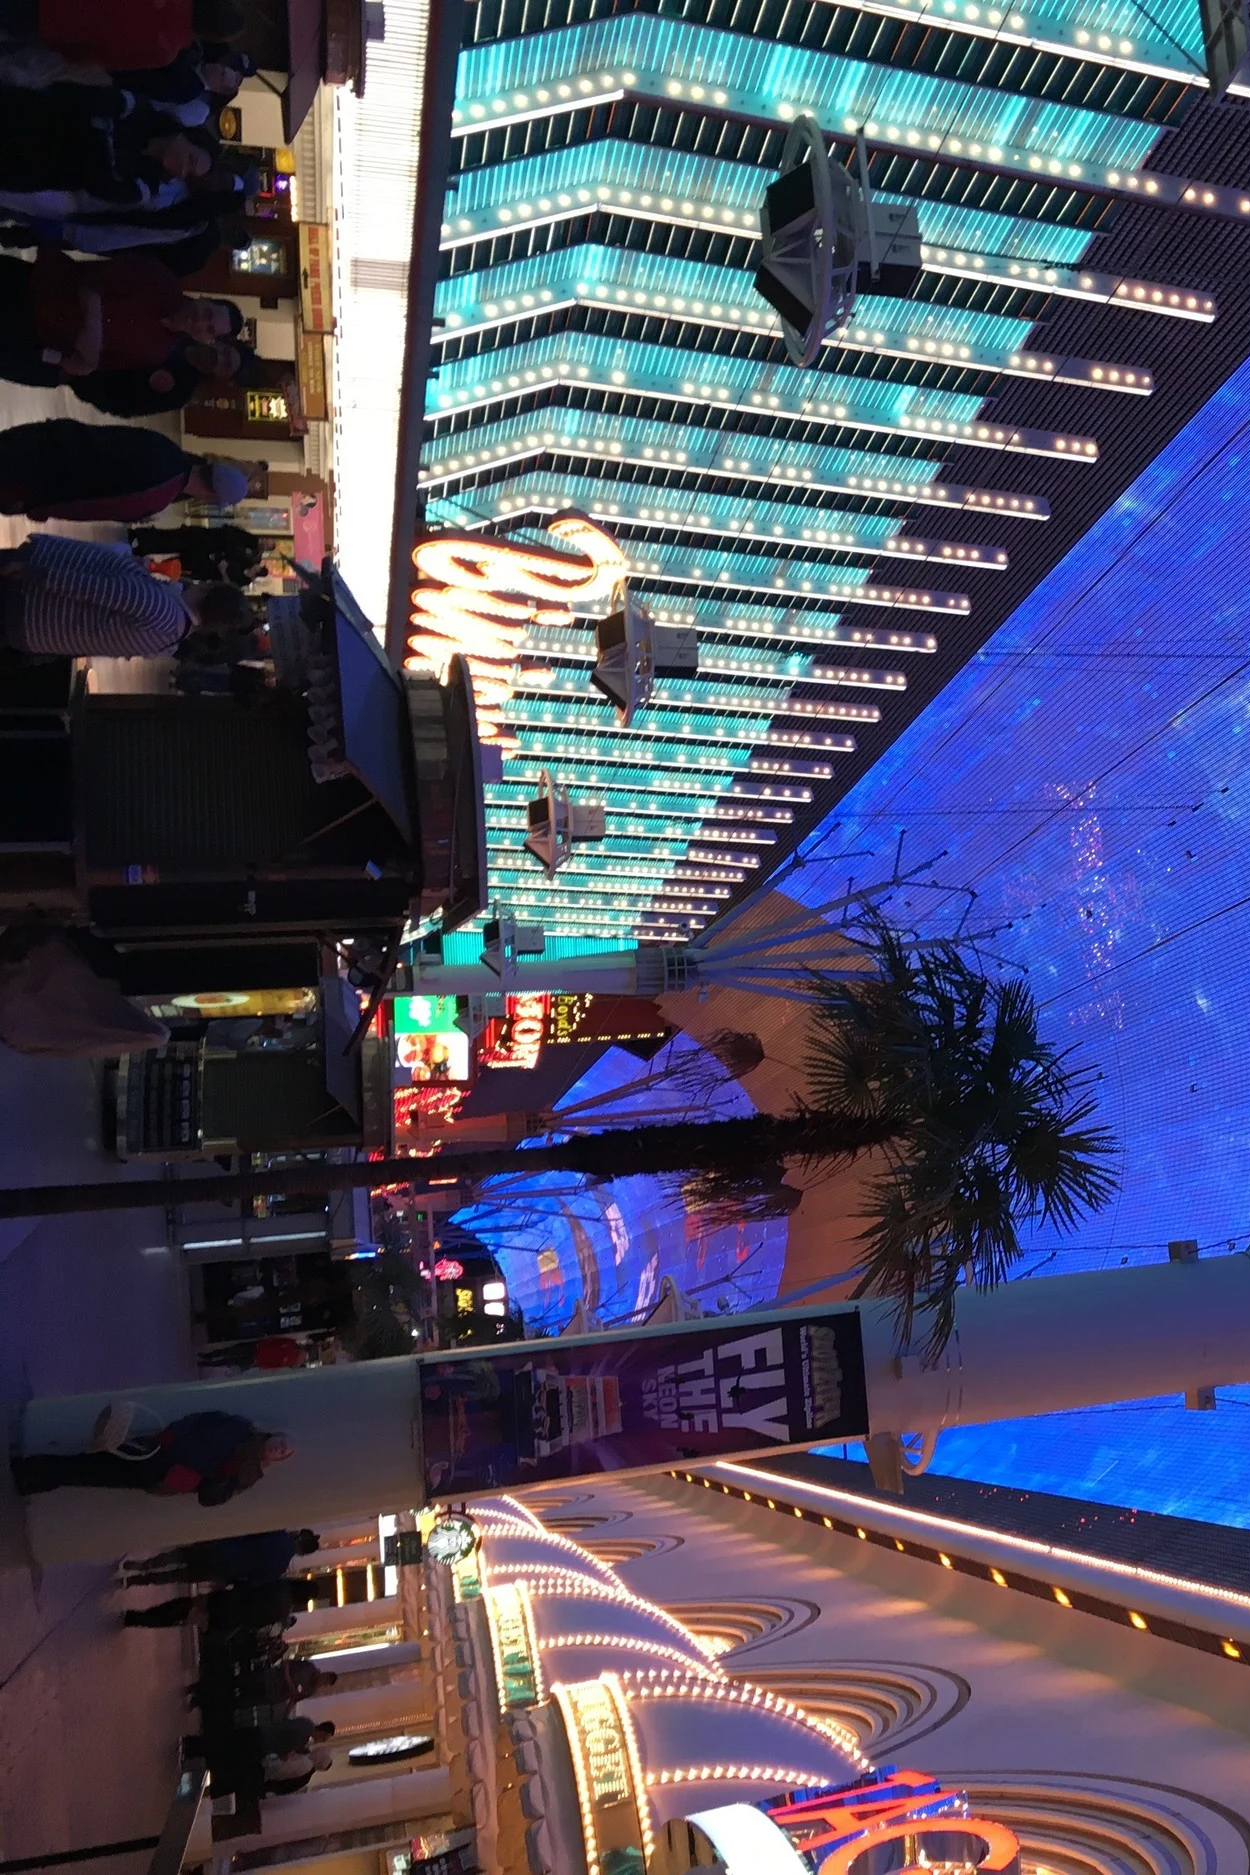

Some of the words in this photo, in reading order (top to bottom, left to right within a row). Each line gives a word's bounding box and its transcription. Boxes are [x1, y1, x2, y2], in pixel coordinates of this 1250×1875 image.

[554, 995, 574, 1036] Boyd's
[641, 1378, 660, 1421] SKY
[656, 1364, 679, 1430] NEON
[677, 1348, 719, 1434] THE
[717, 1327, 790, 1443] FLY
[801, 1360, 811, 1397] Ultimate
